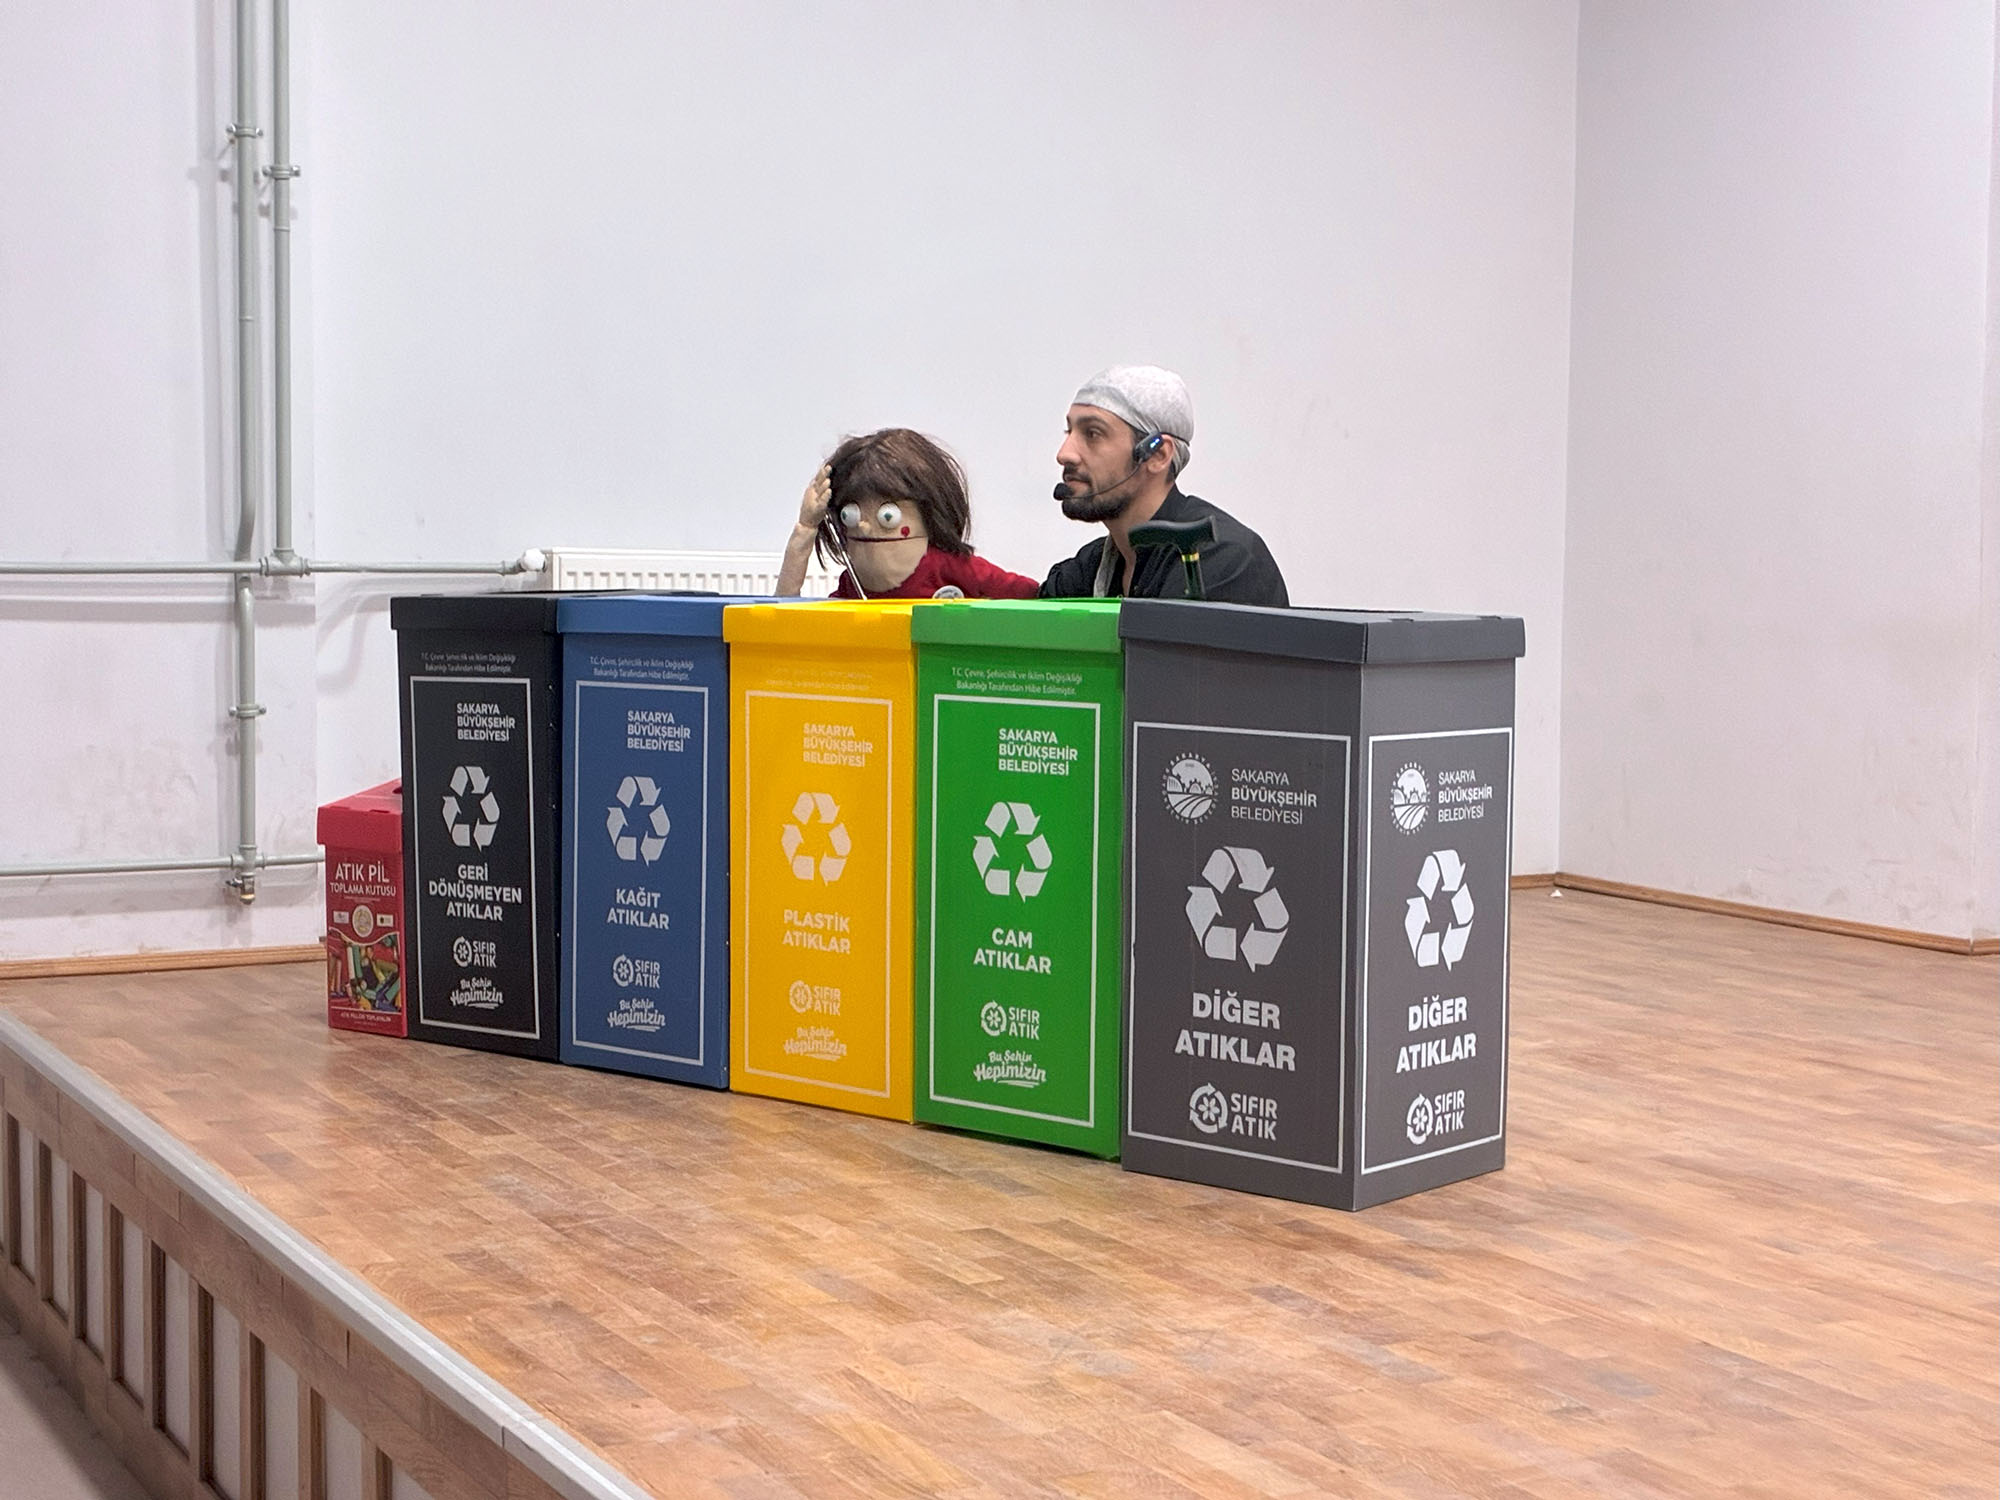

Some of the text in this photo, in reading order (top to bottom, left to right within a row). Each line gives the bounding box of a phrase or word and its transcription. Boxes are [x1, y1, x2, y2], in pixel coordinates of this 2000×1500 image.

[1025, 684, 1041, 692] Hibe
[457, 703, 499, 715] SAKARYA
[628, 711, 674, 724] SAKARYA
[457, 715, 516, 729] BÜYÜKŞEHİR
[627, 724, 691, 739] BÜYÜKŞEHİR
[803, 723, 855, 737] SAKARYA
[457, 728, 509, 741] BELEDİYESİ
[999, 728, 1057, 744] SAKARYA
[627, 737, 683, 752] BELEDİYESİ
[803, 736, 873, 754] BÜYÜKŞEHİR
[998, 742, 1078, 763] BÜYÜKŞEHİR
[803, 751, 865, 767] BELEDİYESİ
[998, 757, 1069, 776] BELEDİYESİ
[1231, 768, 1290, 785] SAKARYA
[1438, 770, 1476, 786] SAKARYA
[1231, 786, 1317, 808] BÜYÜKŞEHİR
[1438, 784, 1492, 804] BÜYÜKŞEHİR
[1231, 805, 1303, 825] BELEDİYESİ
[1438, 802, 1484, 822] BELEDİYESİ
[335, 860, 390, 883] ATIK PİL
[458, 862, 488, 881] GERİ
[330, 882, 397, 897] TOPLAMA KUTUSU
[429, 879, 522, 903] DÖNÜŞMEYEN
[616, 886, 661, 908] KAĞIT
[446, 901, 503, 921] ATIKLAR
[607, 907, 669, 929] ATIKLAR
[783, 909, 851, 933] PLASTİK
[473, 941, 496, 954] SIFIR
[782, 931, 851, 954] ATIKLAR
[992, 928, 1033, 948] CAM
[473, 954, 496, 967] ATIK
[635, 960, 660, 974] SIFIR
[973, 948, 1051, 975] ATIKLAR
[635, 974, 660, 988] ATIK
[450, 988, 504, 1006] Hepimizin
[813, 986, 841, 1001] SIFIR
[813, 1000, 841, 1015] ATIK
[1008, 1007, 1040, 1024] SIFIR
[1192, 989, 1280, 1030] DİĞER
[1408, 994, 1468, 1032] DİĞER
[607, 1009, 666, 1028] Hepimizin
[1009, 1023, 1040, 1040] ATIK
[1175, 1030, 1296, 1071] ATIKLAR
[1396, 1033, 1476, 1074] ATIKLAR
[973, 1061, 1046, 1084] Hepimizin
[1231, 1093, 1278, 1118] SIFIR
[1434, 1089, 1465, 1115] SIFIR
[1231, 1116, 1277, 1141] ATIK
[1435, 1109, 1465, 1135] ATIK
